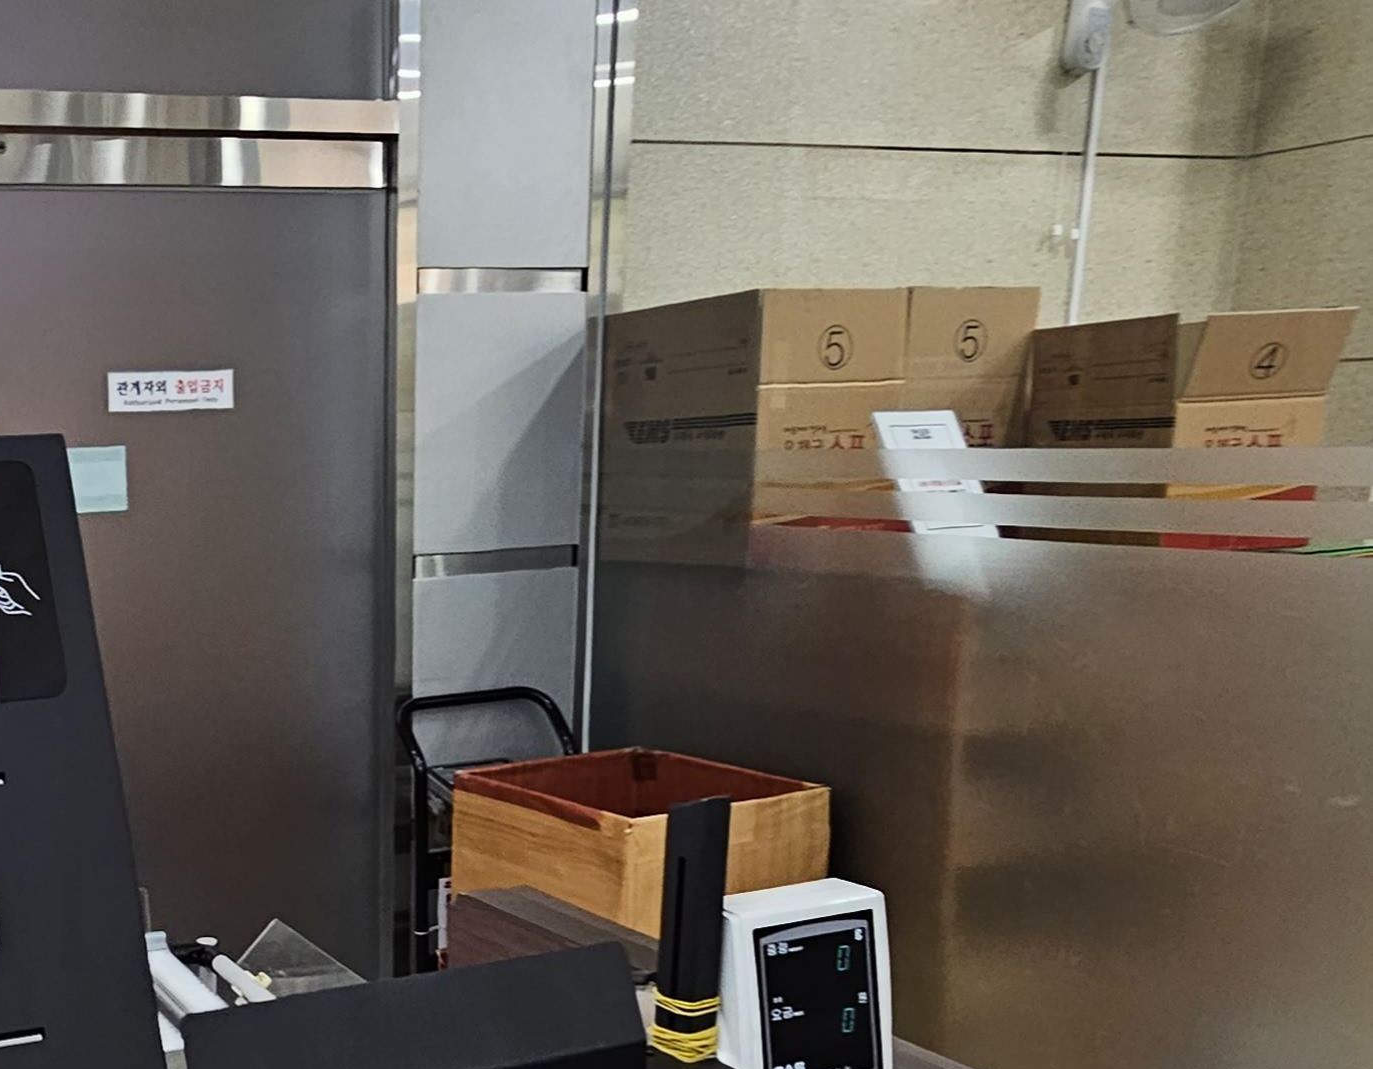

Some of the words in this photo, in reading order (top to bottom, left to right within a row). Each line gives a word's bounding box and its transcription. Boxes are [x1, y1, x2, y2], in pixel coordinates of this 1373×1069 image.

[115, 380, 168, 397] 관계자외
[174, 378, 225, 395] 출입금지
[836, 944, 851, 972] 0
[841, 1007, 856, 1034] 0
